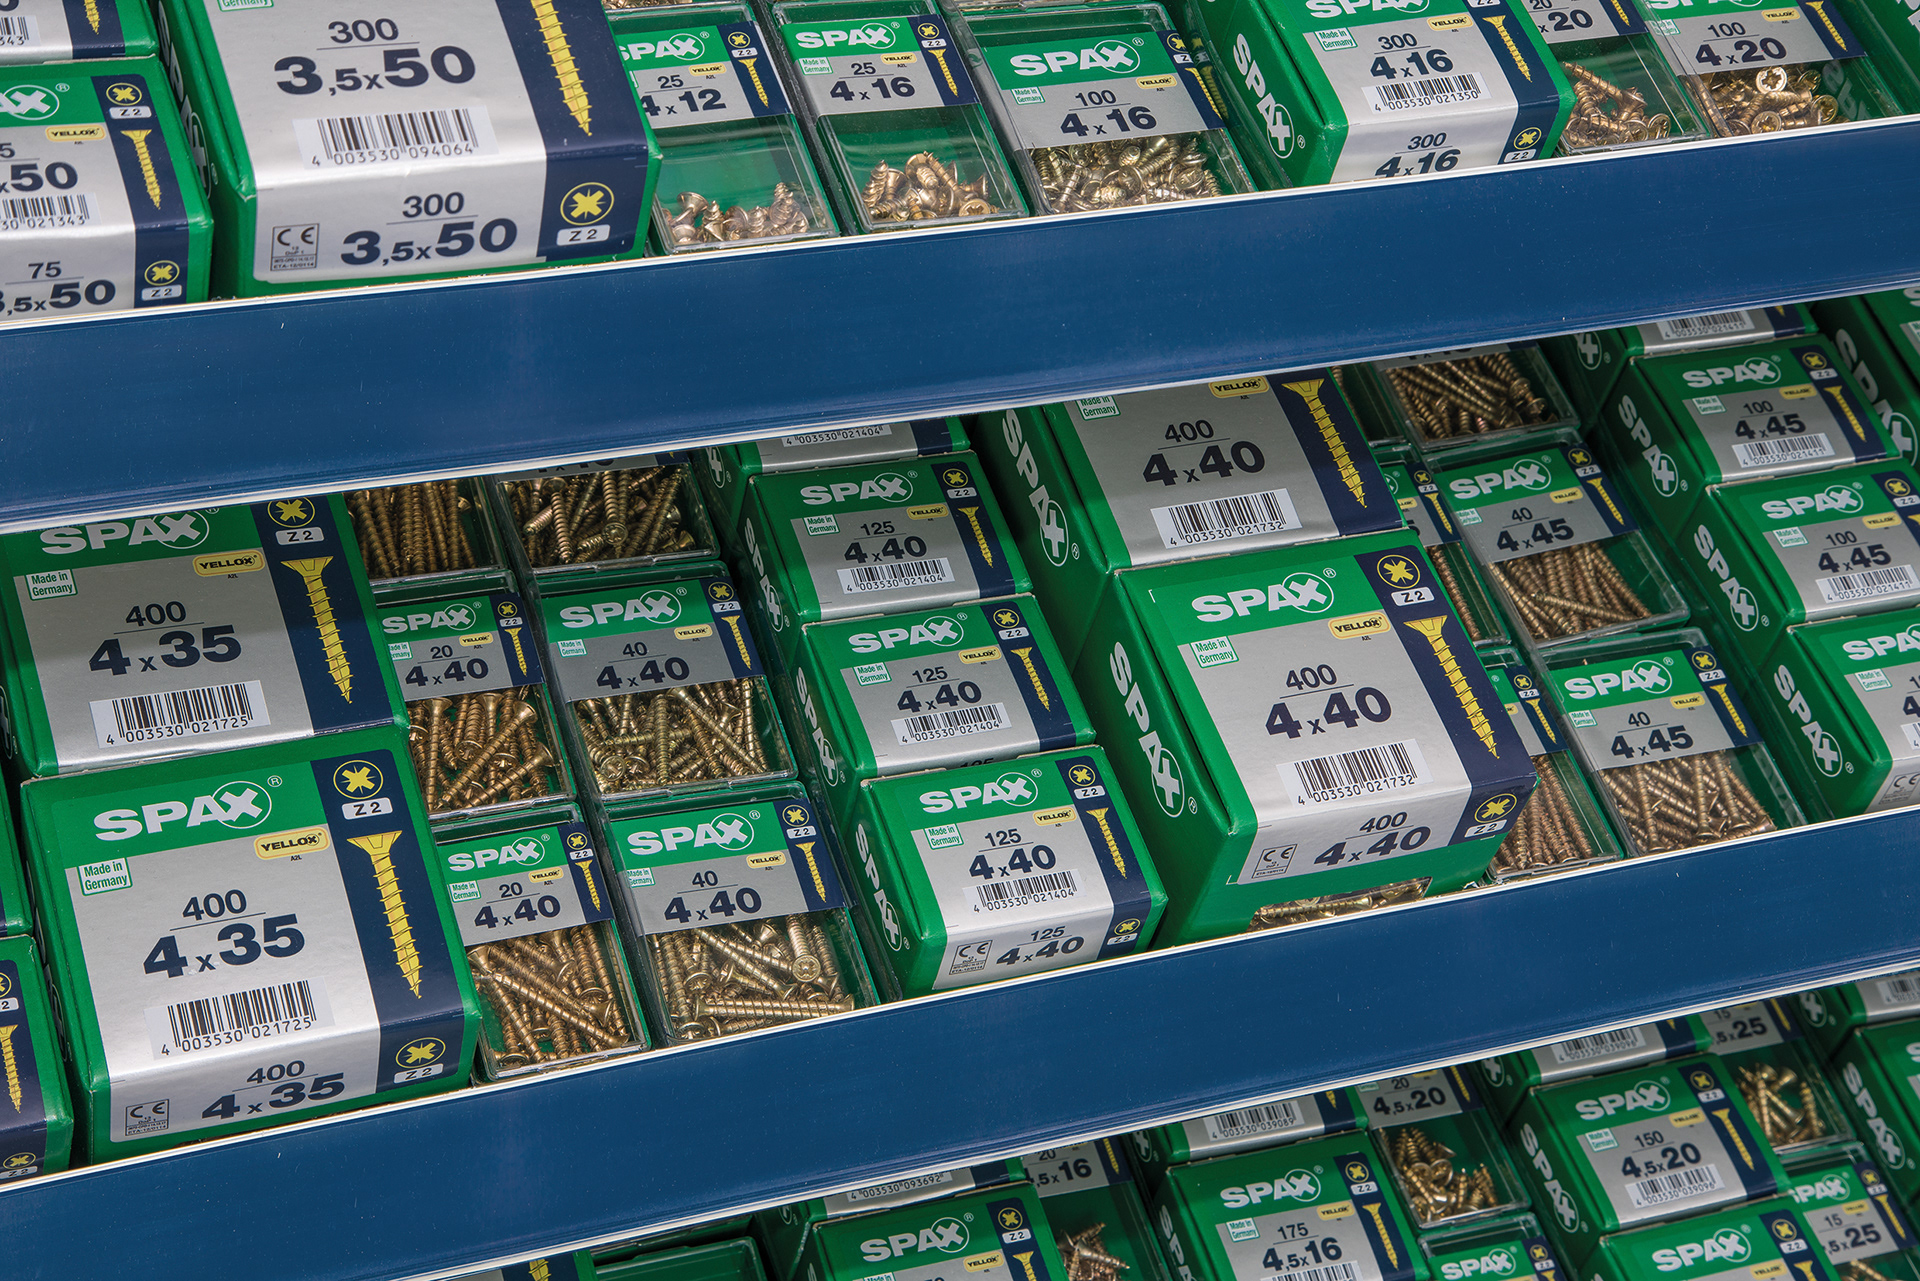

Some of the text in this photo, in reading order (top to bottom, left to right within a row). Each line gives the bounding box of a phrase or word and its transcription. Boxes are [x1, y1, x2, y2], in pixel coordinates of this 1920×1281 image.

[328, 18, 399, 43] 300
[1707, 22, 1746, 38] 100
[1378, 33, 1418, 50] 300
[274, 46, 476, 96] 3,5x50
[851, 62, 876, 76] 25
[657, 75, 684, 89] 25
[1076, 90, 1117, 106] 100
[1388, 98, 1431, 111] 003530
[1436, 90, 1479, 105] 021350
[1407, 133, 1447, 150] 300
[334, 147, 400, 165] 003530
[409, 142, 474, 159] 094064
[403, 192, 465, 218] 300
[341, 218, 518, 267] 3,5x50
[28, 262, 62, 279] 75
[1743, 400, 1774, 416] 100
[799, 431, 838, 444] 003530
[841, 426, 881, 440] 021404
[1165, 419, 1215, 443] 400
[1511, 507, 1532, 521] 40
[860, 521, 896, 537] 125
[1185, 529, 1231, 544] 003530
[1237, 521, 1284, 536] 021732
[1826, 531, 1857, 547] 100
[32, 572, 57, 585] Made
[860, 578, 899, 591] 003530
[903, 573, 943, 585] 021404
[33, 583, 73, 597] Germany
[126, 601, 187, 627] 400
[430, 645, 453, 659] 20
[622, 642, 648, 658] 40
[1196, 642, 1216, 653] Made
[1199, 650, 1235, 665] Germany
[912, 667, 948, 684] 125
[1286, 664, 1338, 690] 400
[1627, 711, 1651, 727] 40
[106, 716, 249, 745] 4 003530 021725
[915, 728, 954, 742] 003530
[959, 721, 999, 735] 021404
[1313, 785, 1361, 804] 003530
[1366, 774, 1416, 793] 021732
[1359, 811, 1409, 833] 400
[929, 827, 946, 837] Made
[931, 833, 960, 845] Germany
[985, 829, 1022, 847] 125
[84, 862, 111, 877] Made
[85, 874, 128, 891] Germany
[691, 870, 719, 887] 40
[499, 882, 523, 898] 20
[182, 889, 247, 921] 400
[1031, 925, 1065, 942] 125
[160, 1016, 312, 1056] 4 003530 021725
[246, 1060, 306, 1084] 400
[1391, 1077, 1409, 1090] 20
[1634, 1131, 1664, 1148] 150
[863, 1185, 900, 1199] 003530
[903, 1174, 941, 1189] 093692
[1824, 1213, 1842, 1227] 15
[1277, 1222, 1309, 1240] 175
[1262, 1237, 1344, 1272] 4,5x16
